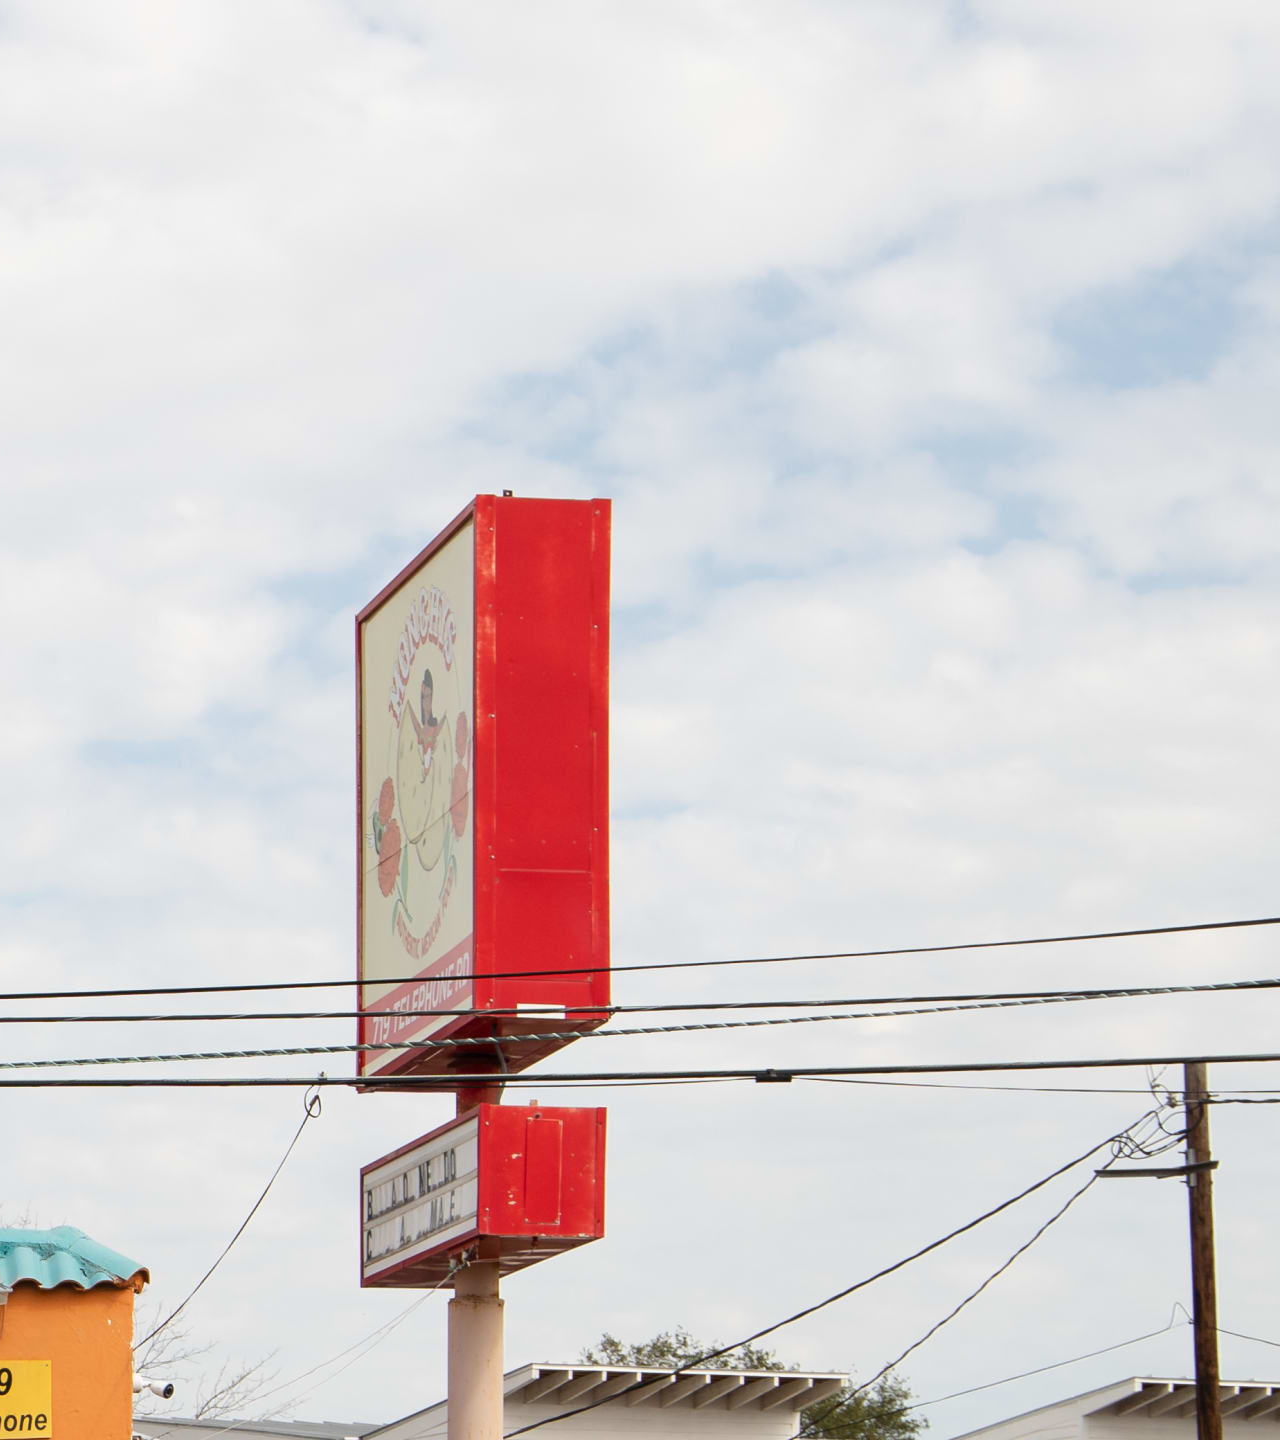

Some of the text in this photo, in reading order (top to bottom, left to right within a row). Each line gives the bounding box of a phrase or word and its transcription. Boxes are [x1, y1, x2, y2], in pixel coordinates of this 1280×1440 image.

[372, 951, 470, 1045] 719 TELEPHONE RD
